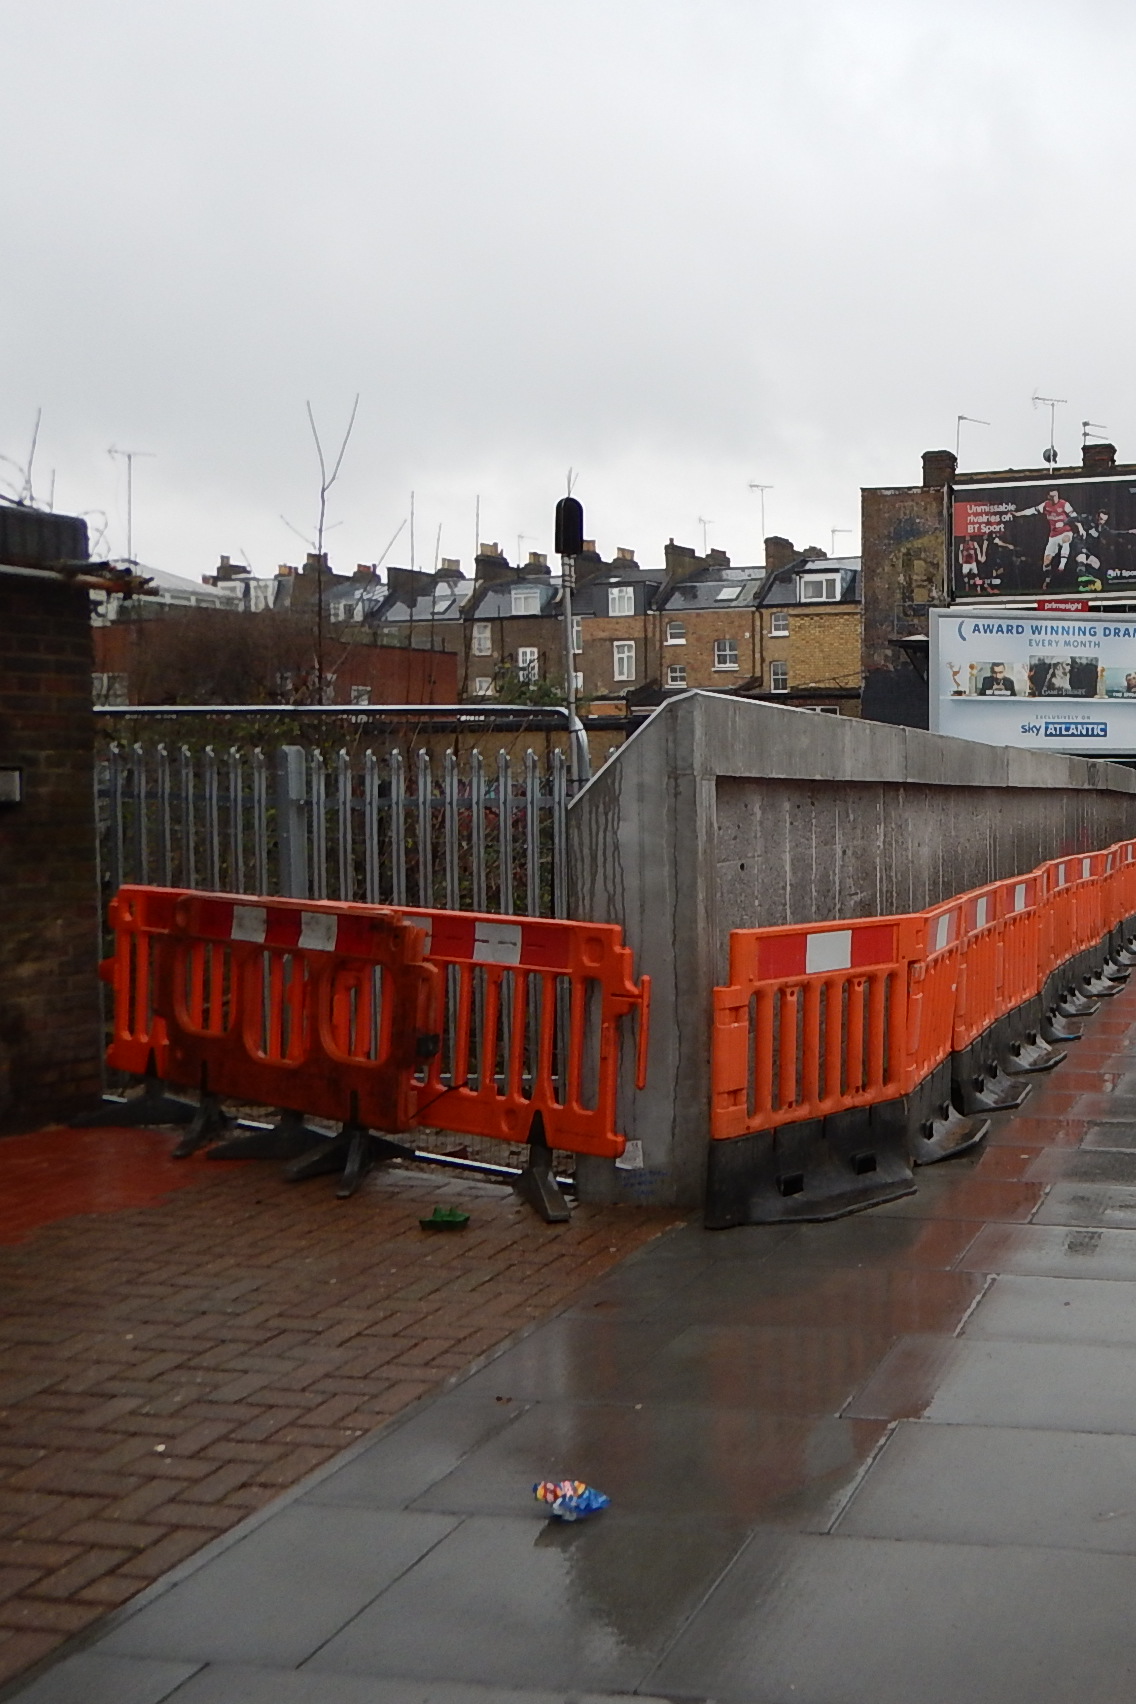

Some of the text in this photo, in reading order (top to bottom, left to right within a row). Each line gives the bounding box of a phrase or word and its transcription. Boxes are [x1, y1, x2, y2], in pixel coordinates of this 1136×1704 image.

[967, 503, 1017, 513] Unmissable
[967, 513, 1013, 523] rivalries on
[967, 523, 1005, 533] BT Sport
[1044, 602, 1082, 610] primesight
[972, 623, 1025, 635] AWARD
[1030, 624, 1098, 637] WINNING
[1028, 638, 1101, 649] EVERY MONTH
[1021, 722, 1105, 736] sky ATLANTIC
